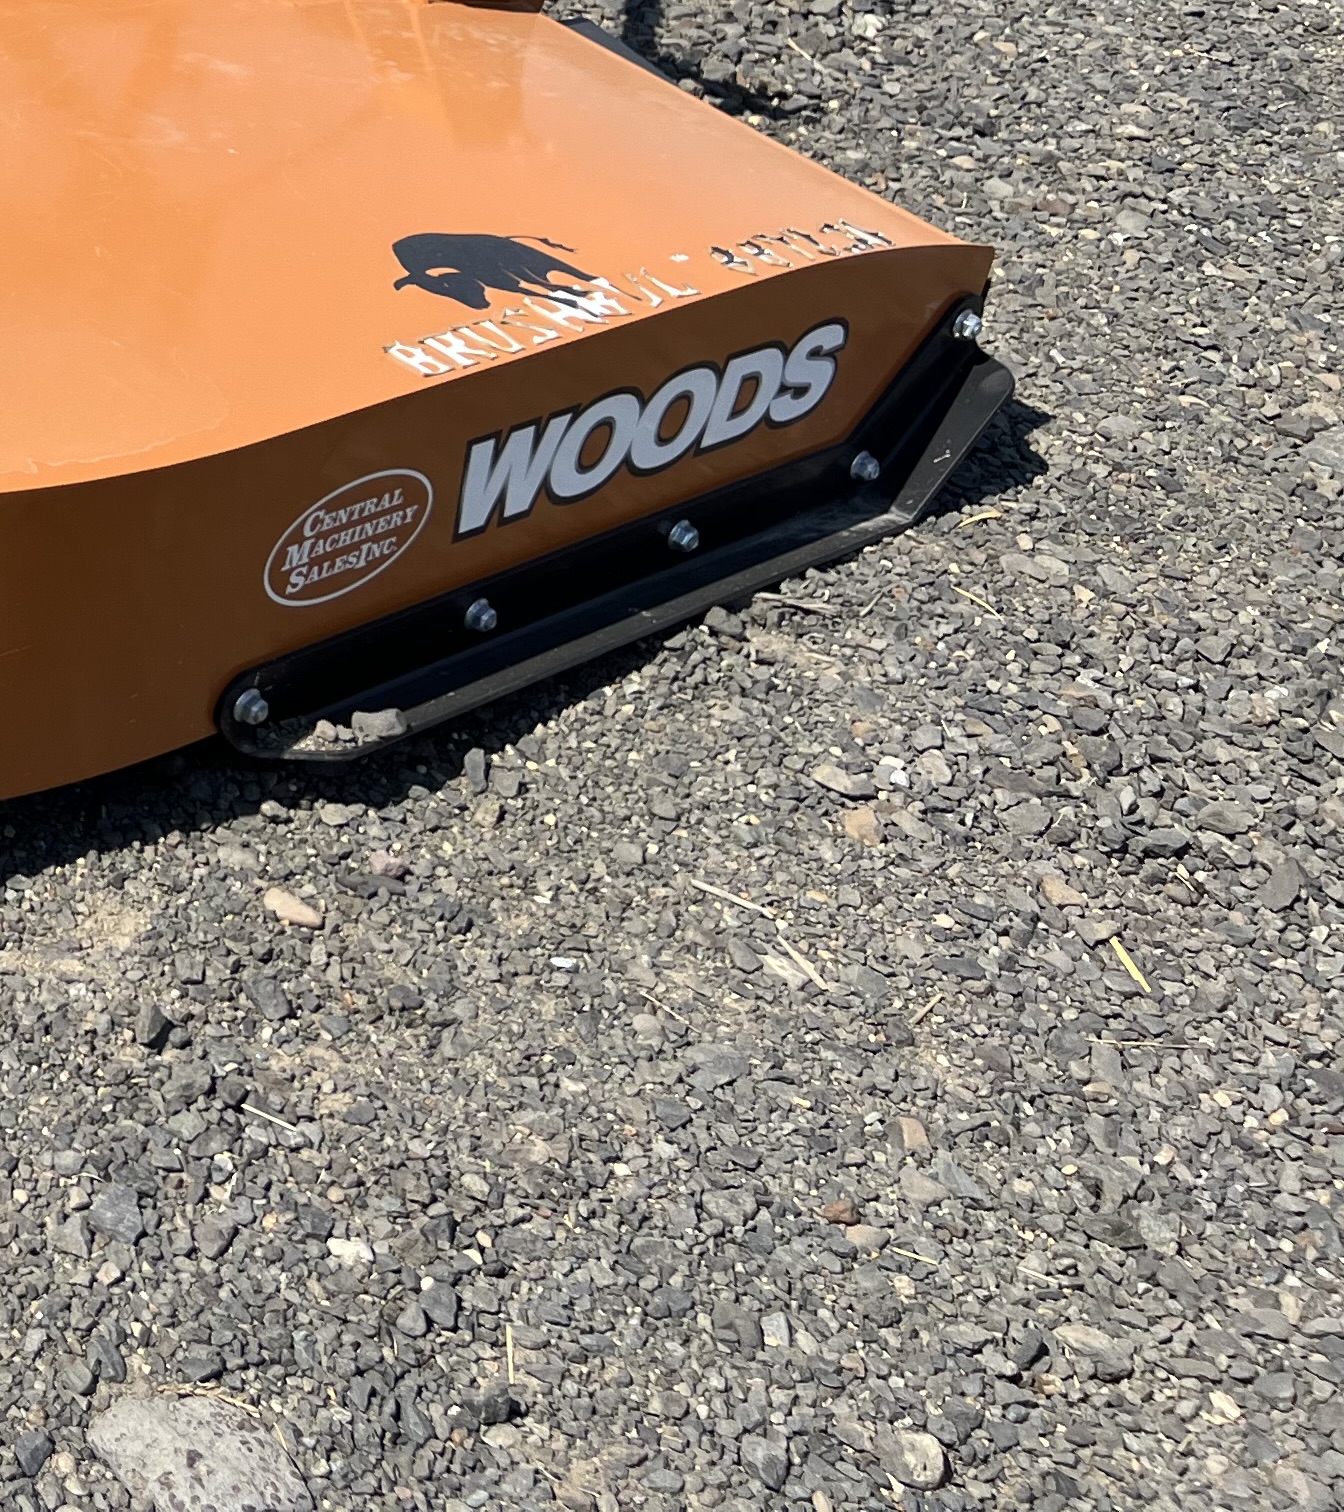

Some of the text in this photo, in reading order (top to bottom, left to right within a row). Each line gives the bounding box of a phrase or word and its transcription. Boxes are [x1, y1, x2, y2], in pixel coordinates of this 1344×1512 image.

[453, 317, 850, 544] WOODS
[280, 504, 419, 572] MACHINERY
[302, 488, 405, 538] CENTRAL
